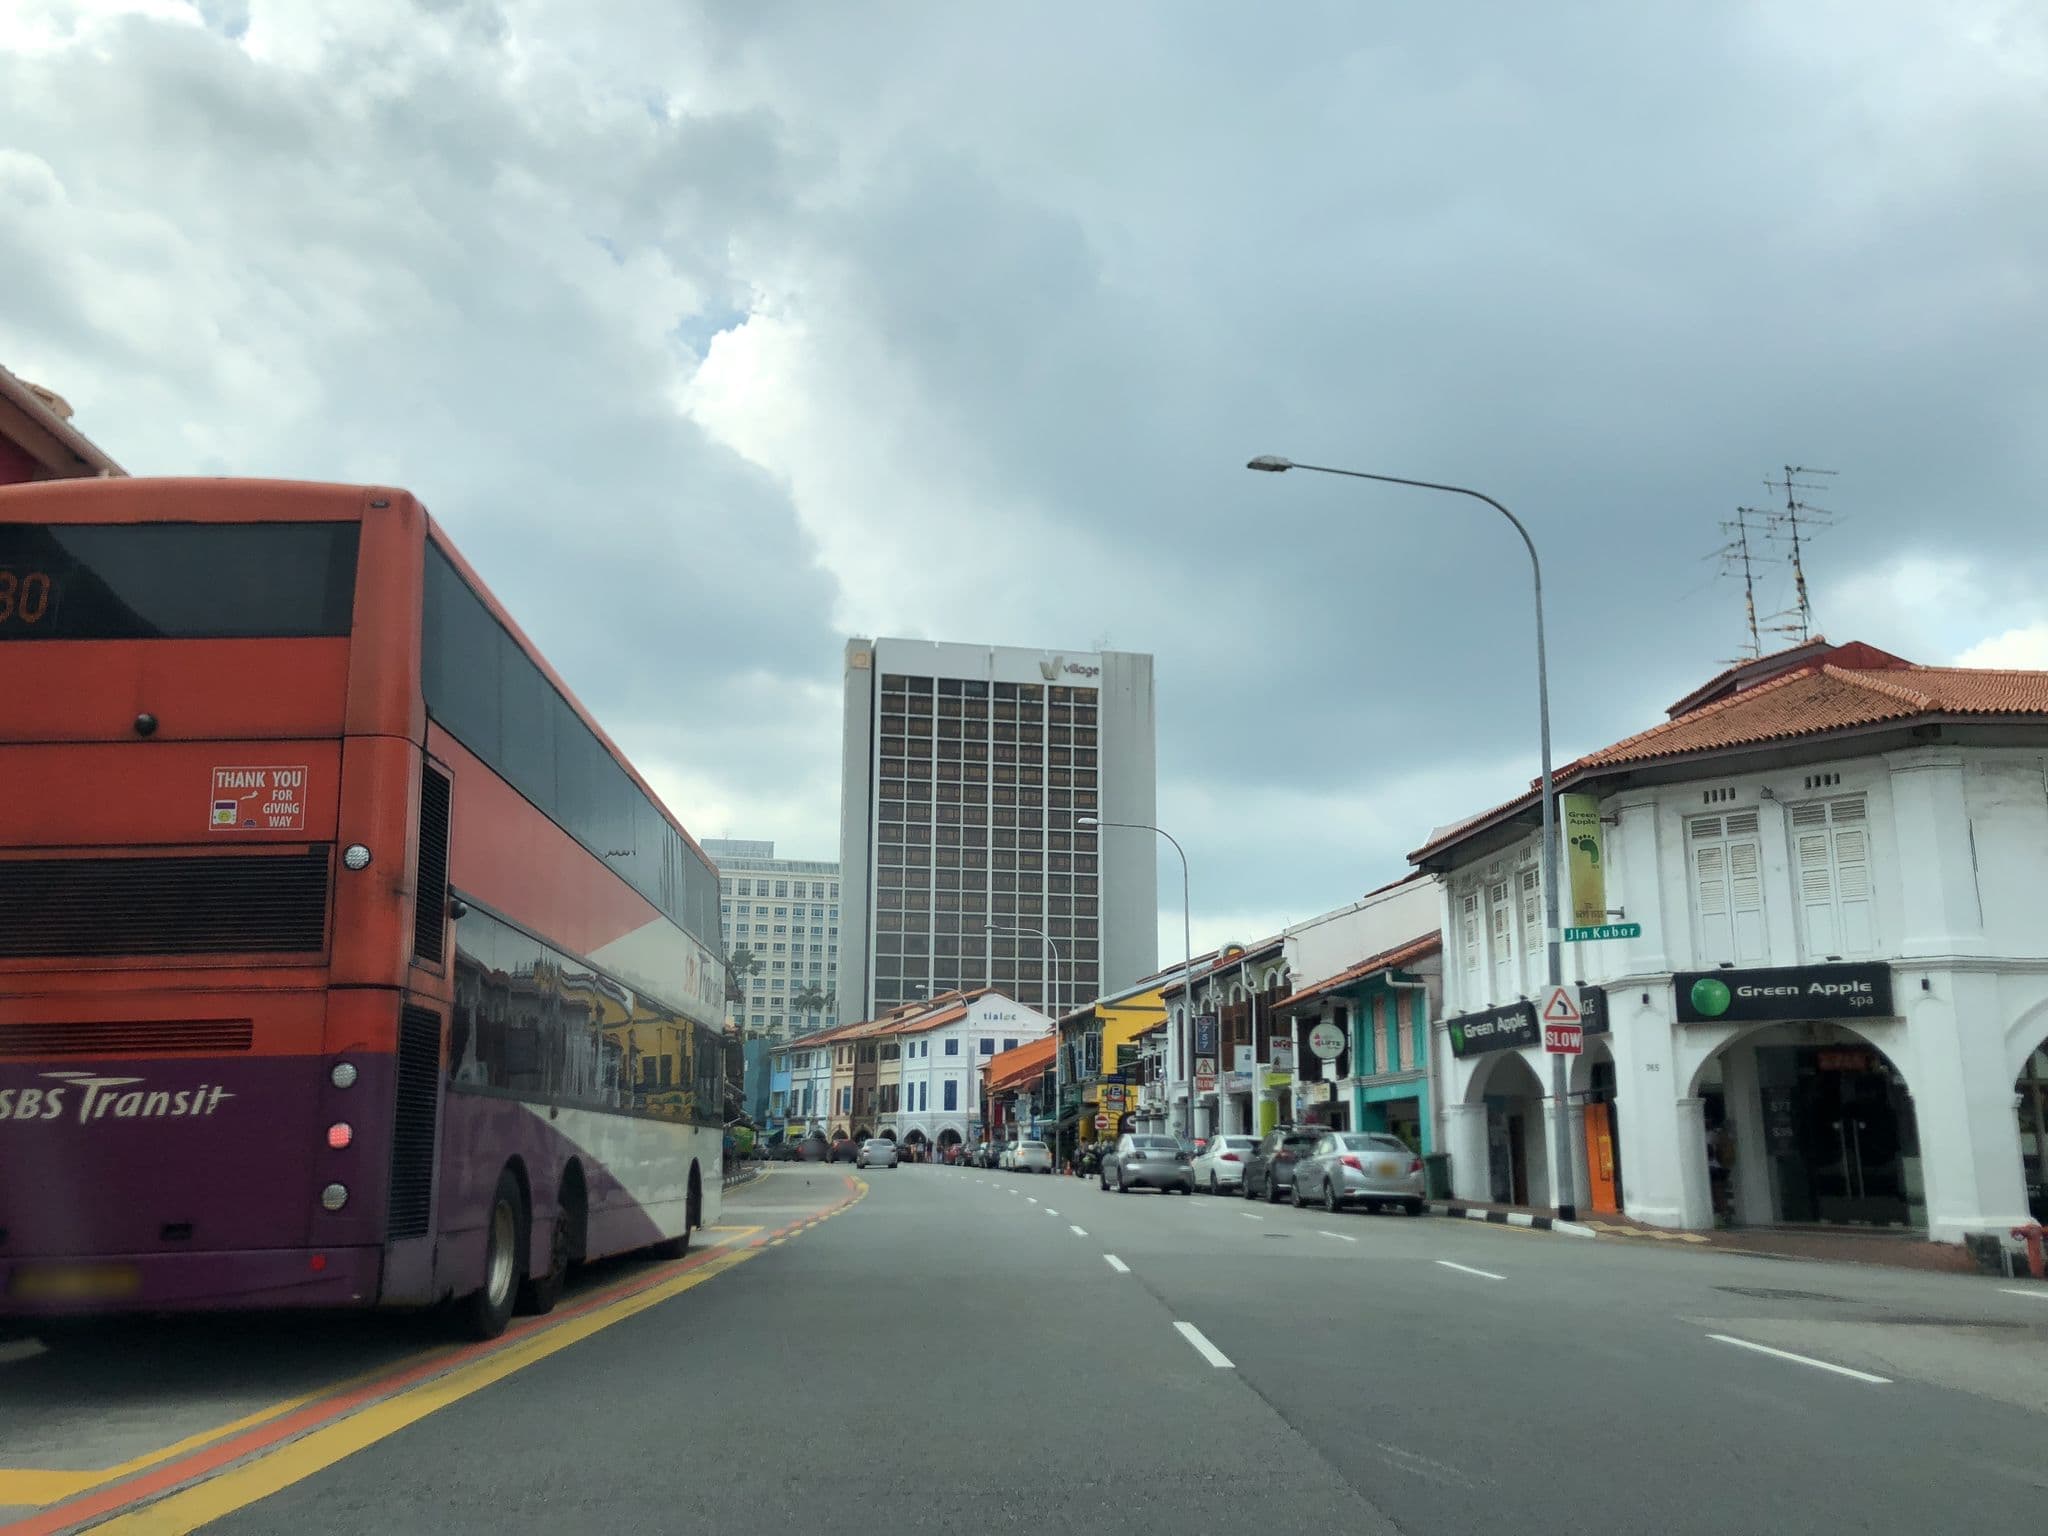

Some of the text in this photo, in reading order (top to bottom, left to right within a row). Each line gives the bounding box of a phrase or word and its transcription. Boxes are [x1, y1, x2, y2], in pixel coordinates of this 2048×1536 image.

[1063, 663, 1100, 678] village
[216, 771, 301, 788] THANK YOU
[272, 789, 293, 801] FOR
[263, 803, 300, 815] GIVING
[268, 816, 293, 827] WAY
[1568, 927, 1637, 941] Jln Kubor
[1737, 981, 1872, 997] Green Apple
[1849, 996, 1874, 1007] spa
[1464, 1020, 1495, 1038] Green
[1497, 1013, 1528, 1034] Apple
[1546, 1030, 1582, 1049] SLOW
[0, 1077, 237, 1124] SBS Transit
